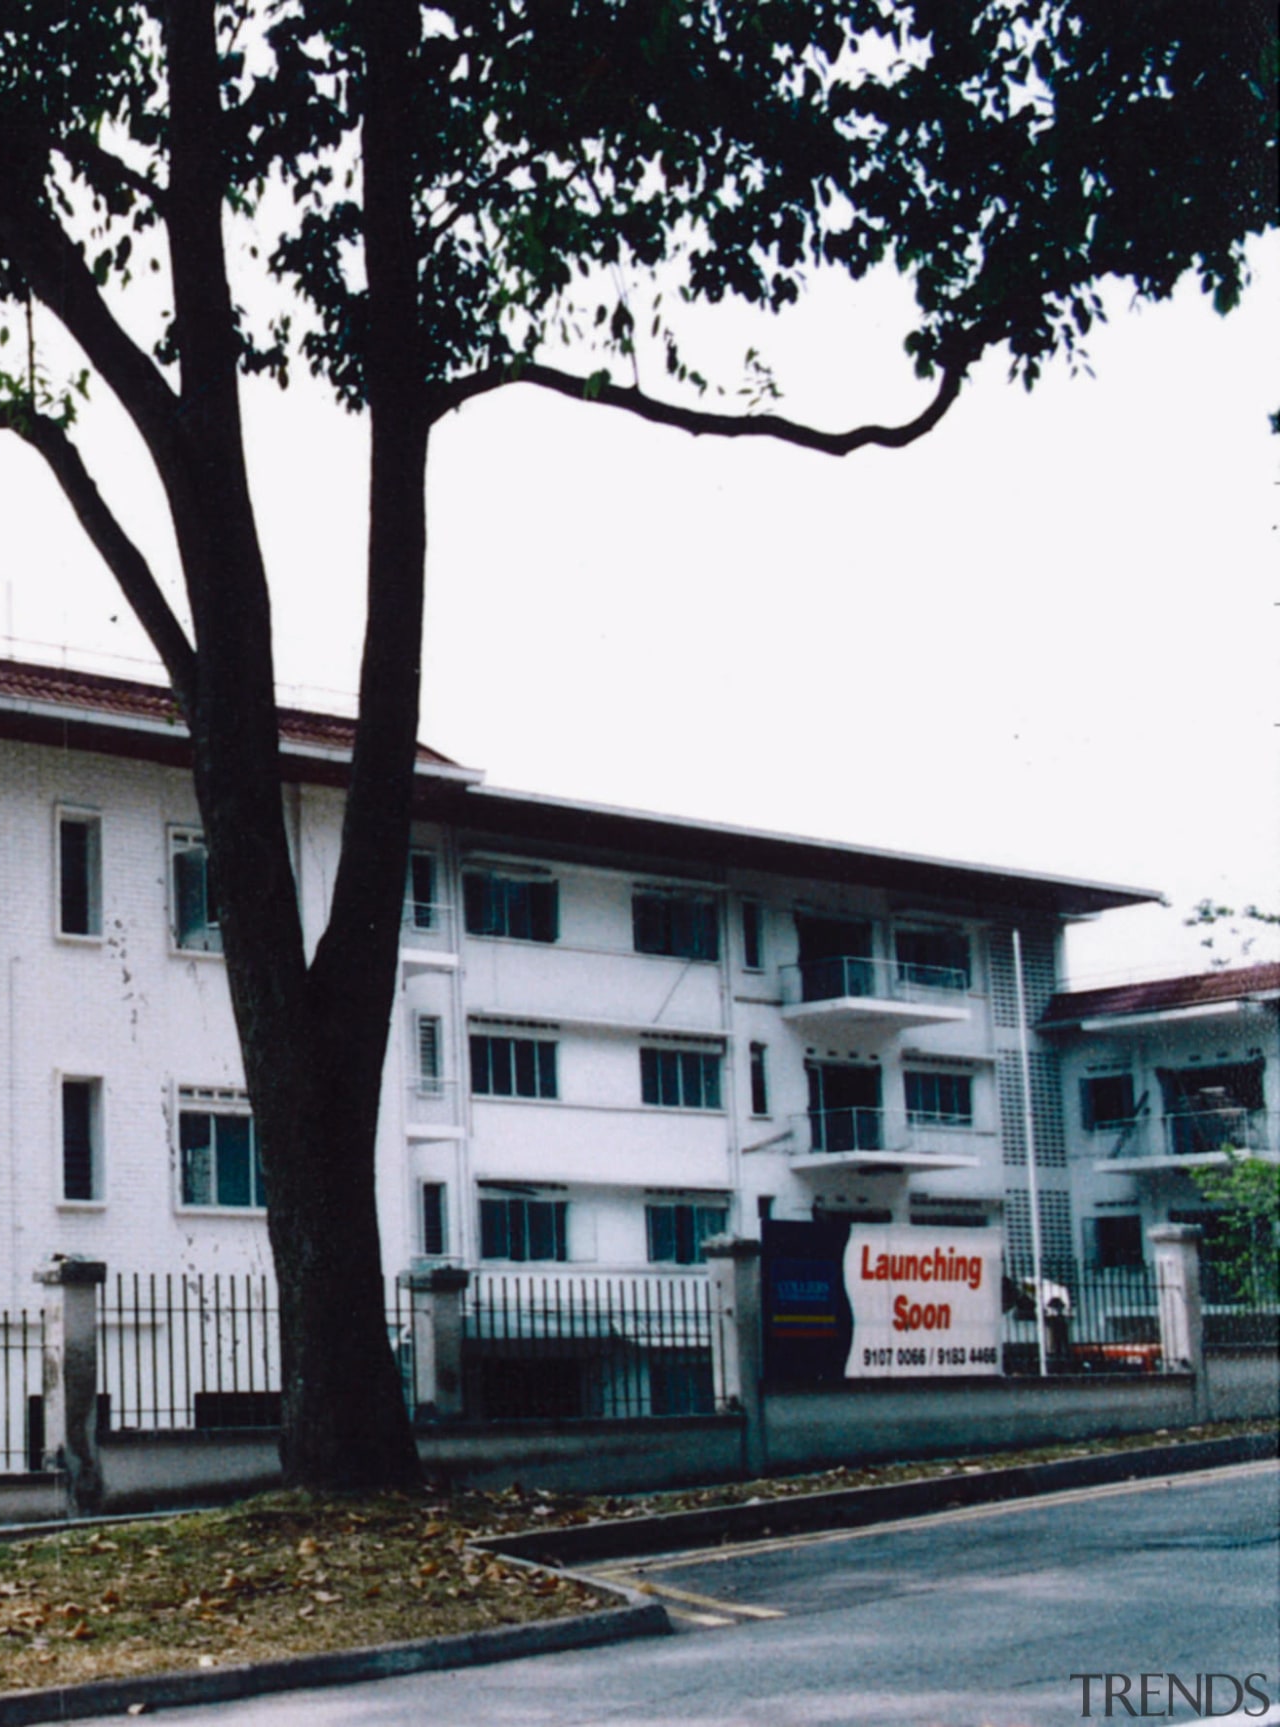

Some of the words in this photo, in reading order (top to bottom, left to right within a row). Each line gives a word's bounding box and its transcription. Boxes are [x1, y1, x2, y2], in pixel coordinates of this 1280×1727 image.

[861, 1244, 982, 1290] Launching
[892, 1295, 951, 1331] Soon
[863, 1348, 893, 1366] 9107
